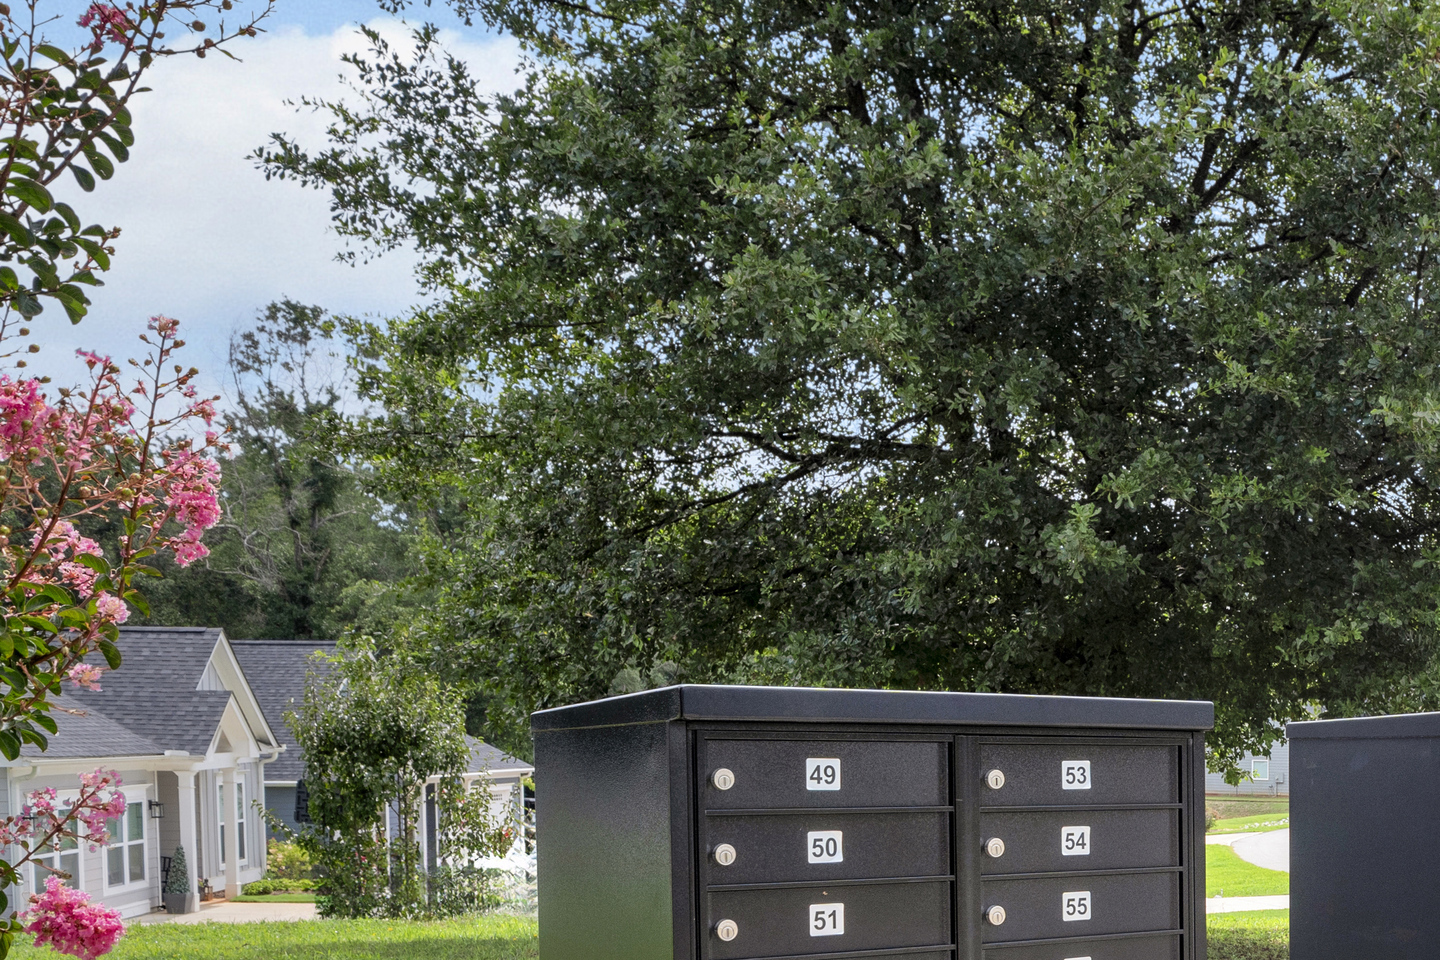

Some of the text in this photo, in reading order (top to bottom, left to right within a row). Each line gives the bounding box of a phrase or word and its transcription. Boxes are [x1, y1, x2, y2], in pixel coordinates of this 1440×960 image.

[810, 764, 836, 785] 49
[1065, 766, 1087, 785] 53
[812, 838, 838, 858] 50
[1064, 832, 1087, 850] 54
[1066, 898, 1088, 916] 55
[814, 910, 838, 930] 51
